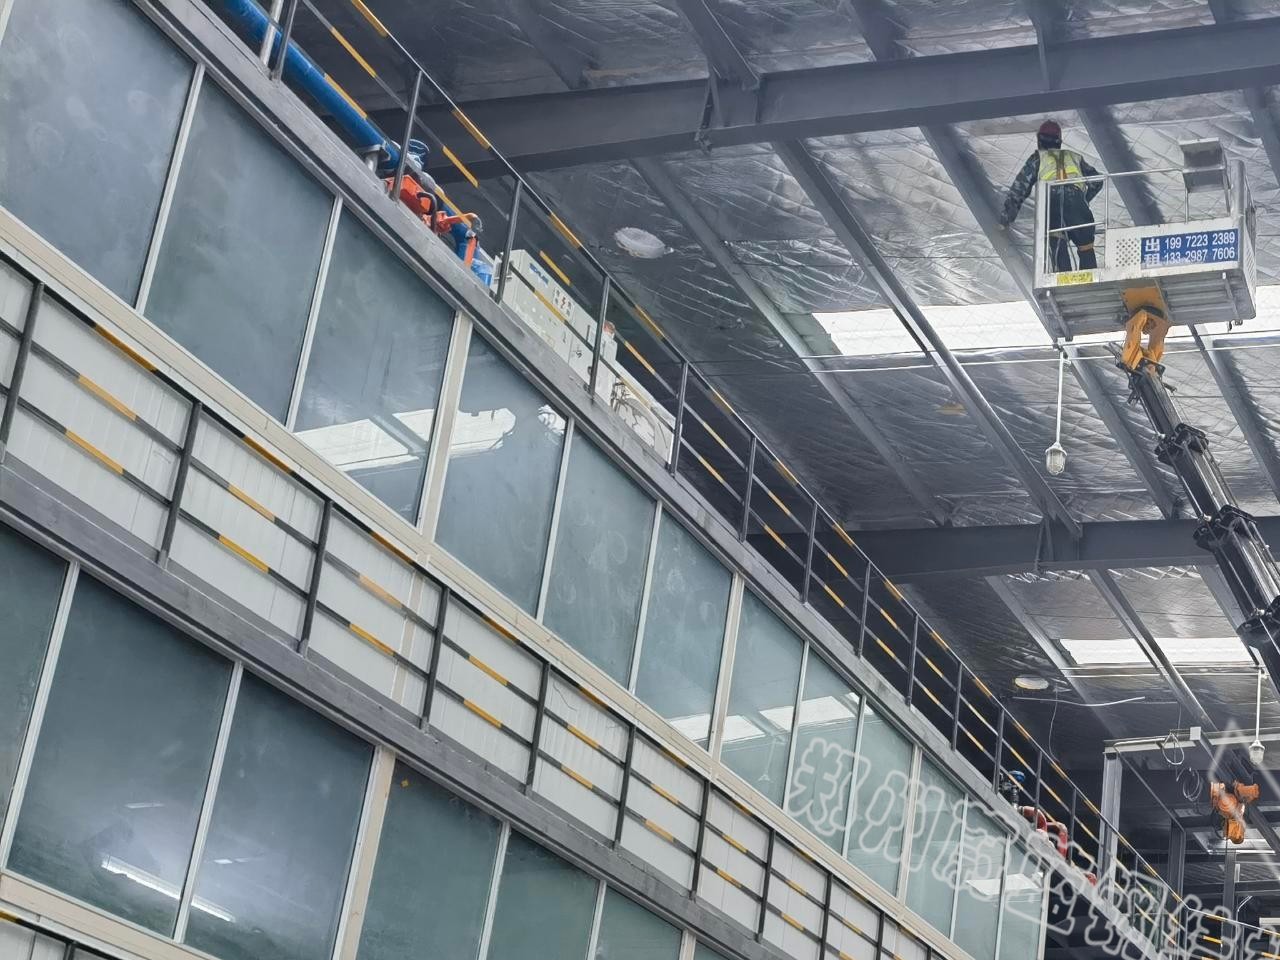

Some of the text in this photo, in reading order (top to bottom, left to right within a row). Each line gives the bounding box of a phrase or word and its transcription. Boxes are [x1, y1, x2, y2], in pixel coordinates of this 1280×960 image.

[1165, 232, 1235, 249] 199 7223 2389
[1165, 247, 1235, 265] 133 2987 7606
